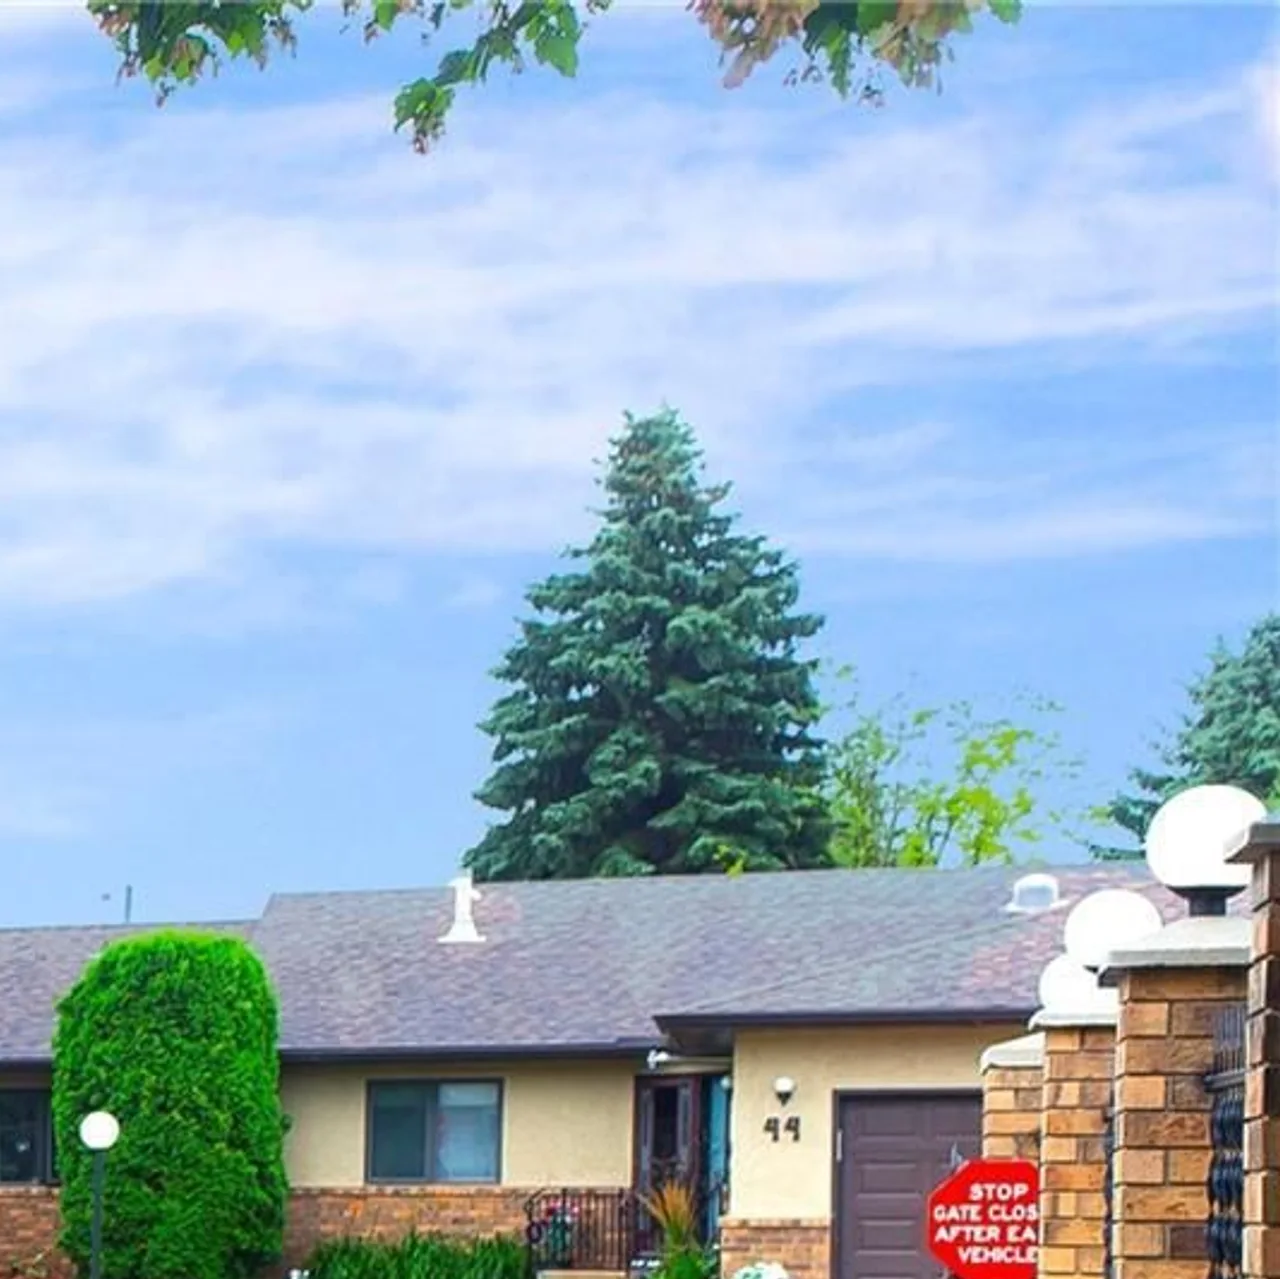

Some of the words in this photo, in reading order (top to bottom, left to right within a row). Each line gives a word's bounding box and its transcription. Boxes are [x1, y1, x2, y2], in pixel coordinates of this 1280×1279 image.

[764, 1117, 800, 1142] 44
[969, 1183, 1029, 1200] STOP
[934, 1204, 982, 1221] GATE
[988, 1204, 1038, 1221] CLOS
[934, 1225, 1001, 1242] AFTER
[1007, 1225, 1037, 1242] EA
